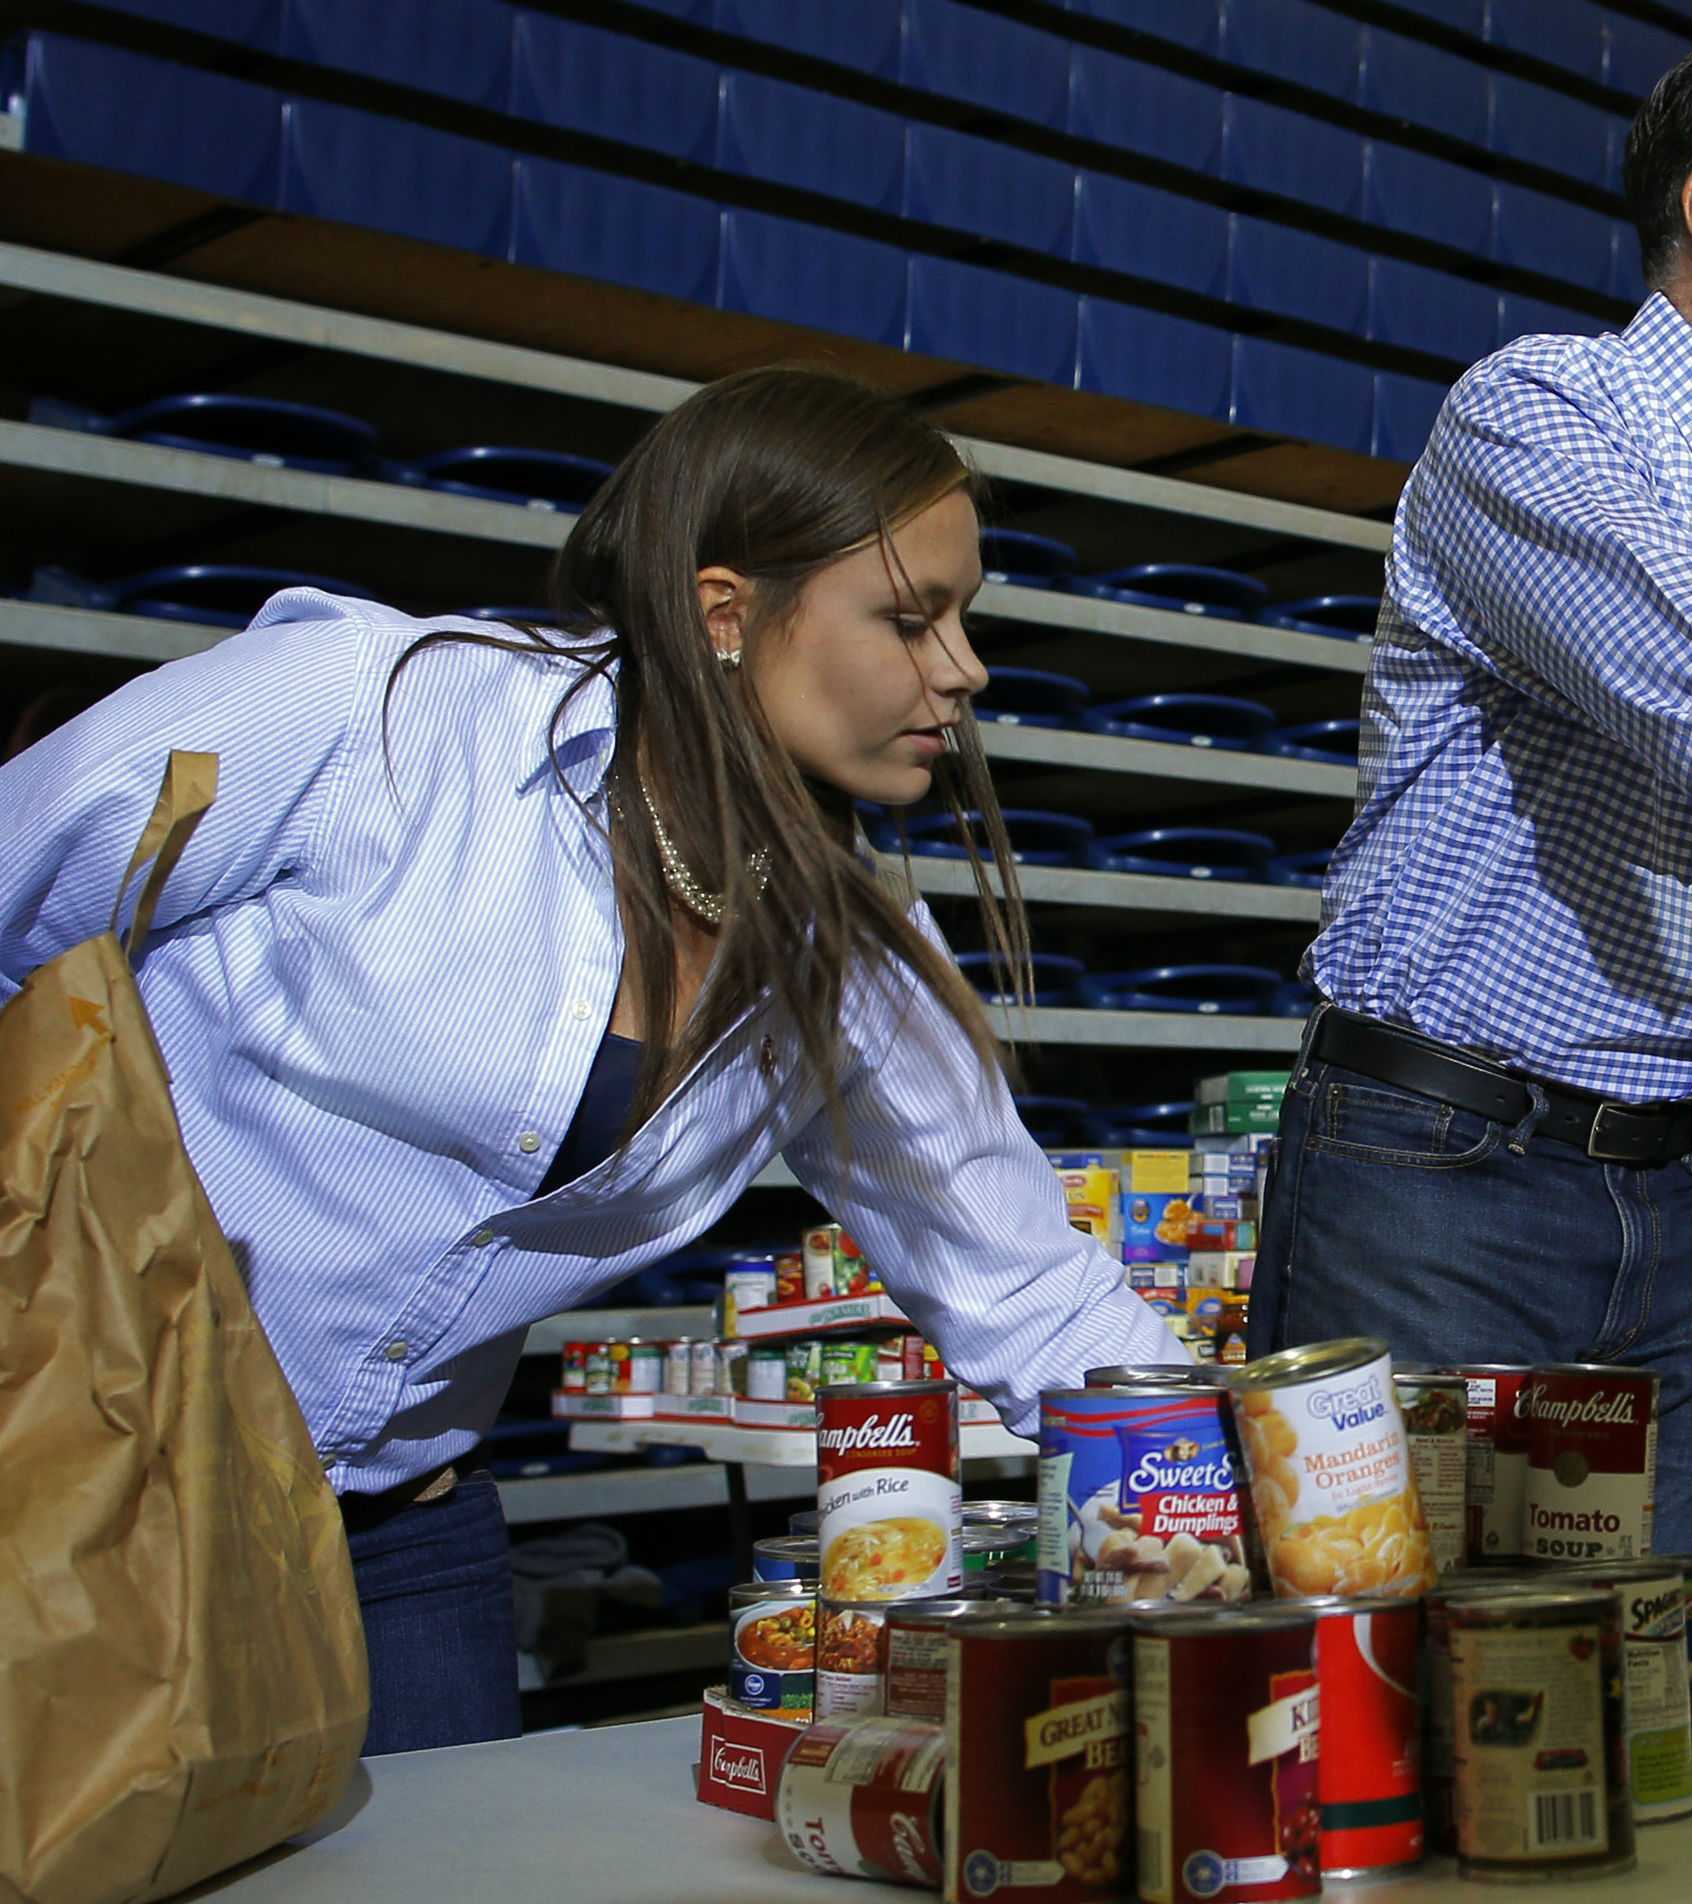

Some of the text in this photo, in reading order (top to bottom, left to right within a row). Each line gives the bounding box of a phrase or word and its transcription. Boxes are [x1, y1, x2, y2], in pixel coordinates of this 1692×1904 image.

[1307, 1374, 1382, 1420] Great
[1332, 1402, 1385, 1432] Value
[816, 1412, 916, 1456] ampbell's
[1303, 1431, 1400, 1474] Mandarin
[1315, 1452, 1401, 1490] Oranges
[876, 1478, 909, 1496] Rice
[1158, 1493, 1239, 1515] Chicken &
[1529, 1503, 1621, 1533] Tomato
[1153, 1514, 1239, 1536] Dumplings
[1536, 1537, 1604, 1559] SOUP
[1040, 1707, 1105, 1747] GREAT
